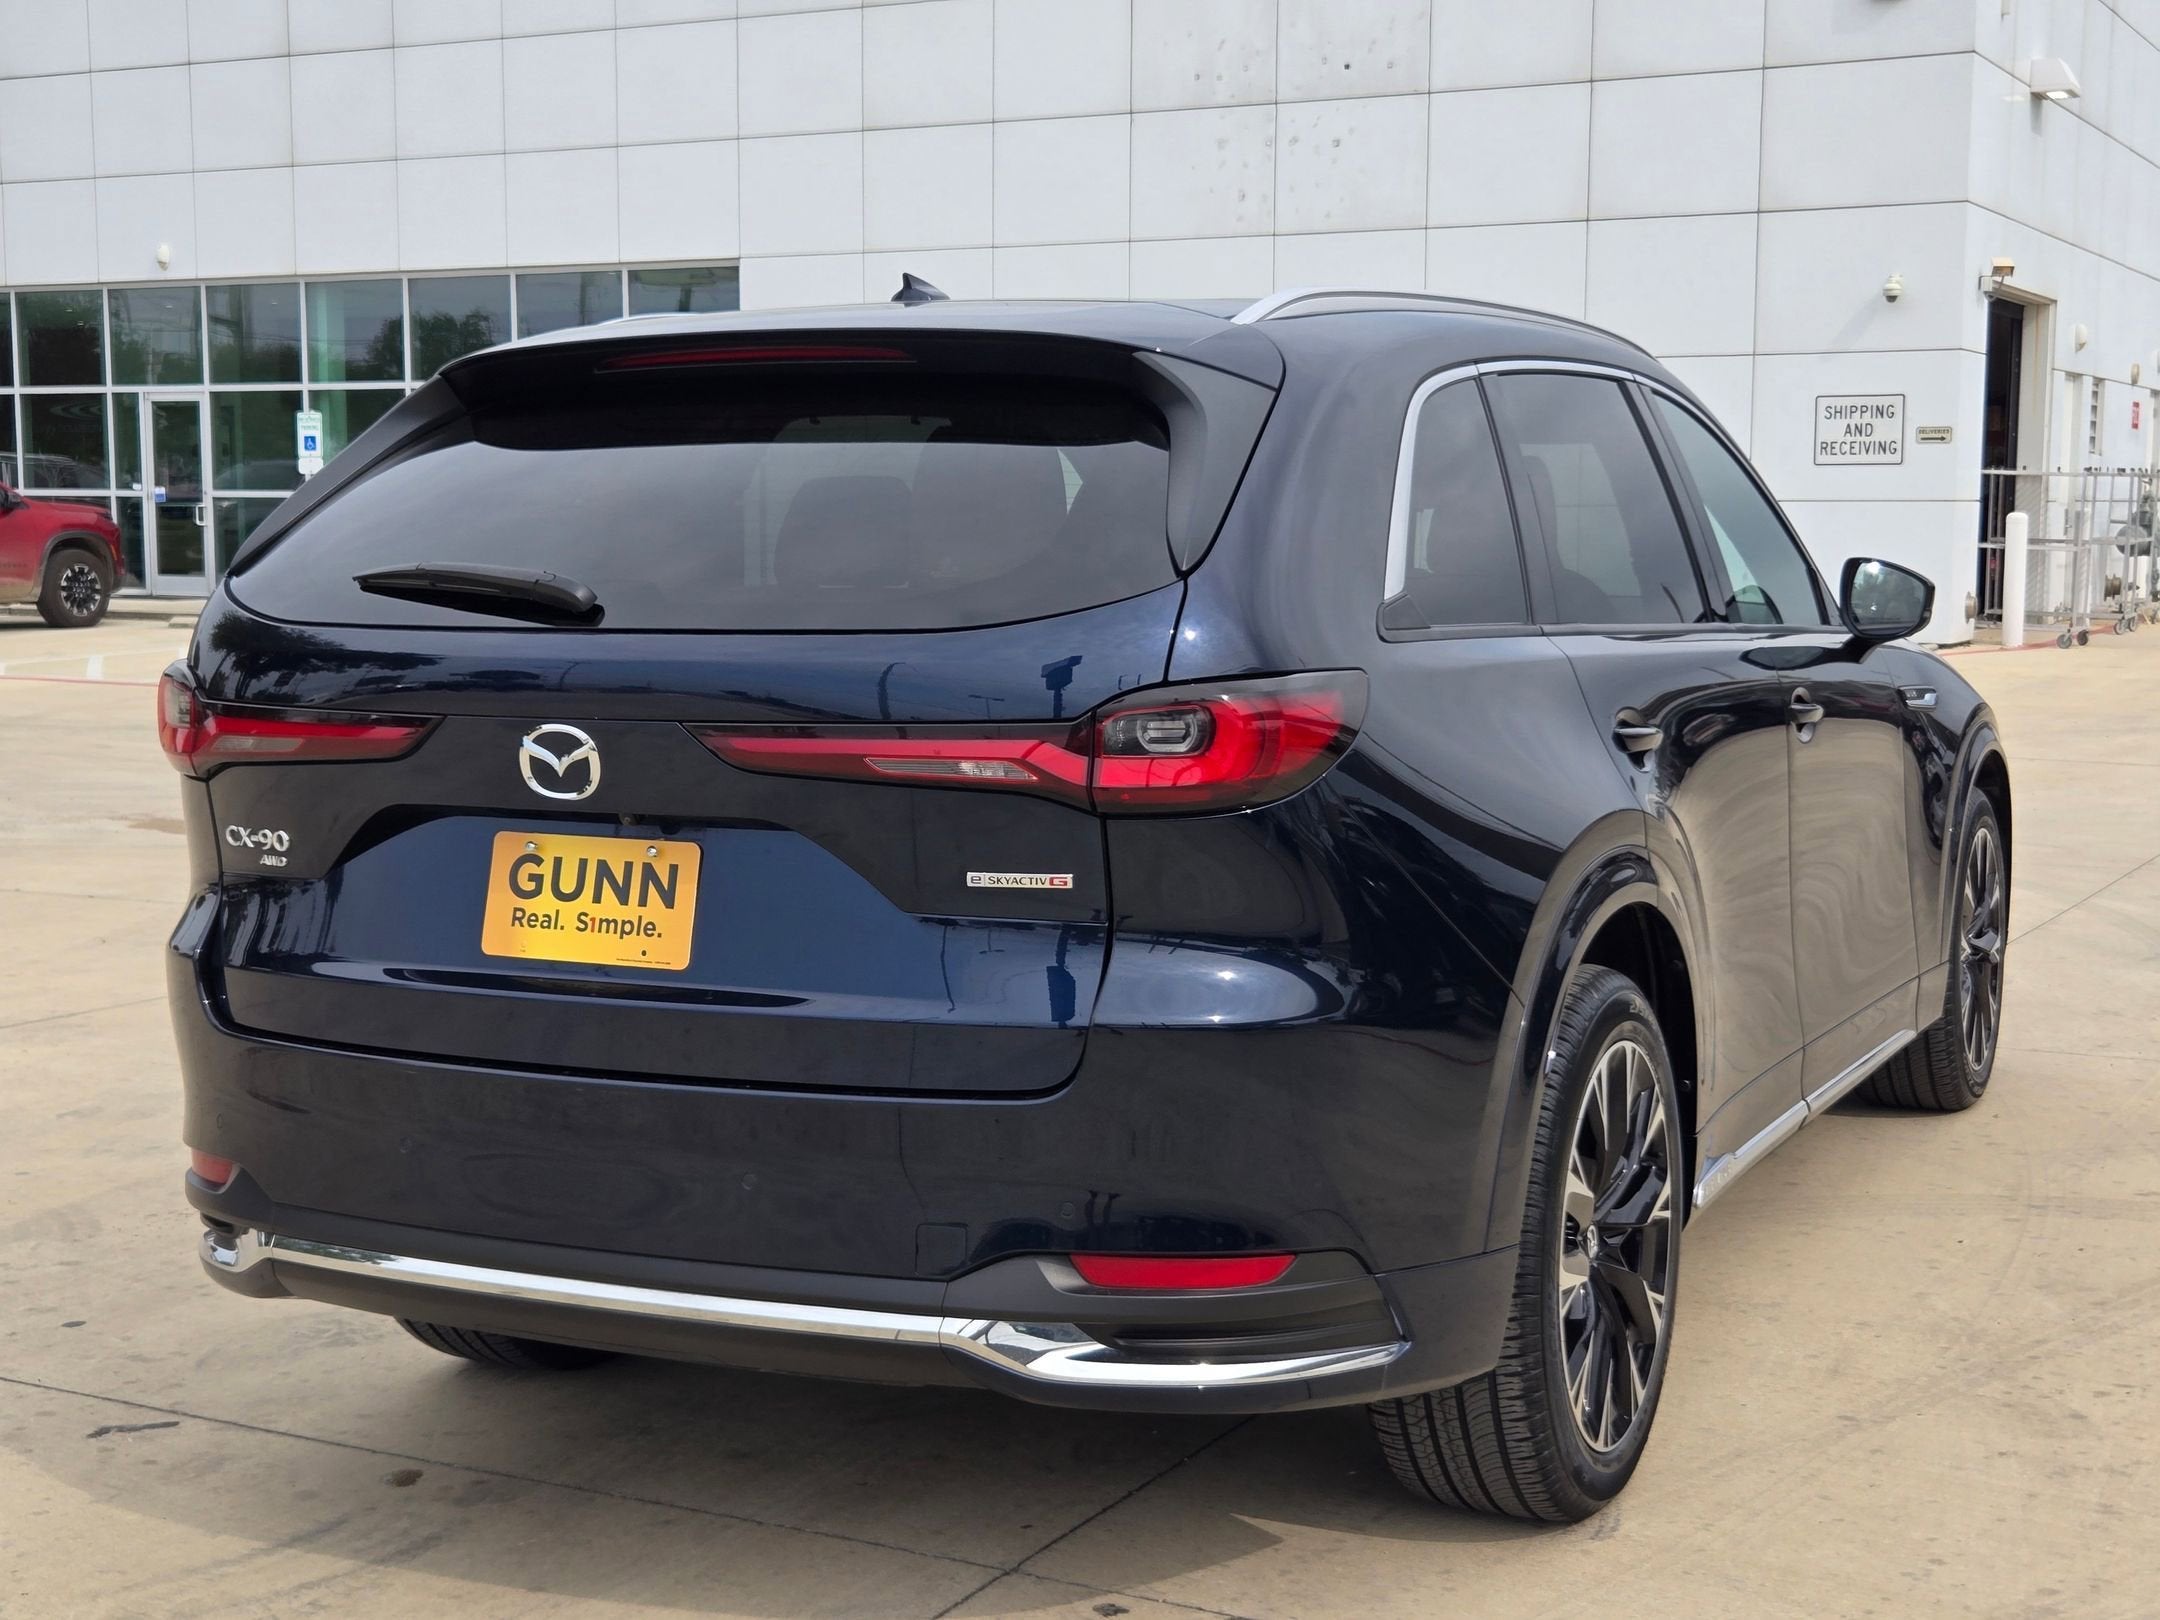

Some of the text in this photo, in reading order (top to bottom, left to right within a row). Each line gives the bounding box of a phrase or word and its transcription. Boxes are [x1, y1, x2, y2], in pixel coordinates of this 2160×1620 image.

[1824, 404, 1895, 420] SHIPPING
[1843, 423, 1873, 438] AND
[1819, 440, 1897, 456] RECEIVING
[225, 824, 290, 852] CX-90
[259, 854, 288, 867] AWD
[508, 853, 679, 910] GUNN
[510, 906, 565, 931] Real.
